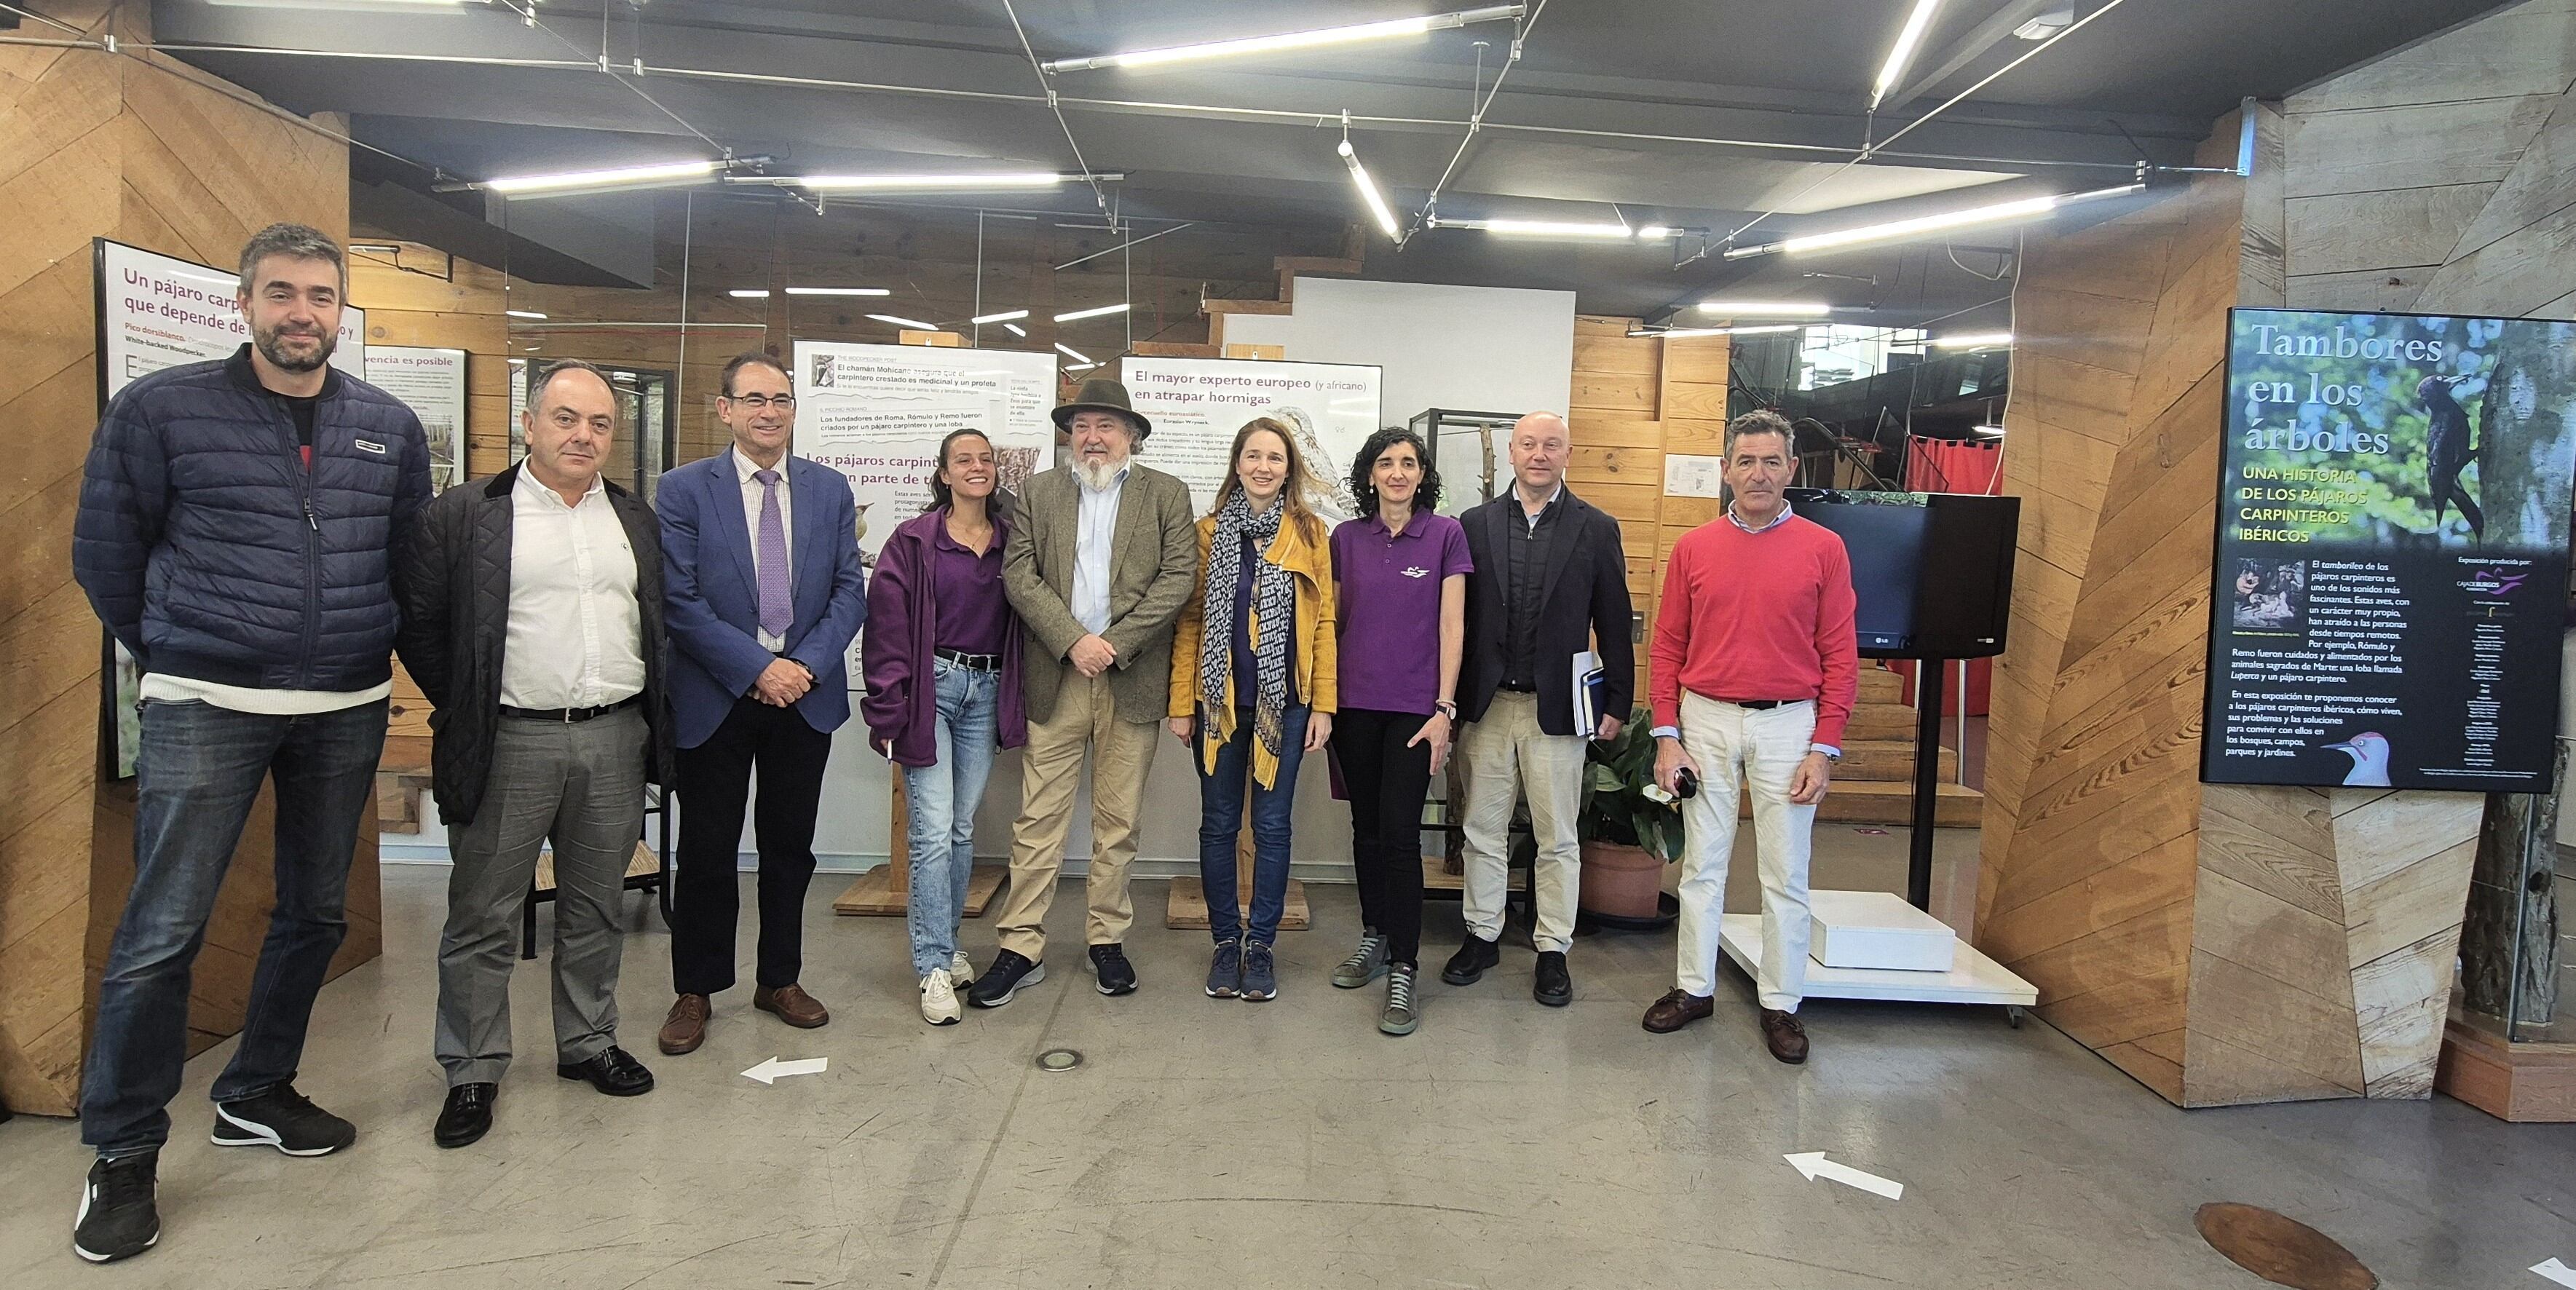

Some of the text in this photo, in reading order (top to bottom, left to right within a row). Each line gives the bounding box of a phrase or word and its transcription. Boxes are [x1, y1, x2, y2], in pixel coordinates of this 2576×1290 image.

[125, 267, 240, 313] Un pájaro carp
[125, 297, 245, 335] que depende de
[125, 322, 141, 332] Pico
[348, 328, 353, 340] y
[125, 335, 168, 349] White-backed
[2251, 324, 2443, 362] Tambores
[365, 355, 399, 364] vencia
[416, 358, 453, 366] posible
[1136, 371, 1367, 391] El mayor experto europeo (y africano)
[2249, 373, 2363, 406] en los
[1135, 391, 1271, 406] en atrapar hormigas
[2245, 418, 2388, 454] árboles
[835, 454, 885, 467] pájaros
[889, 456, 938, 470] carpint
[861, 474, 898, 486] parte
[903, 474, 919, 484] de
[2243, 467, 2356, 483] UNA HISTORIA
[2242, 487, 2368, 505] DE LOS PÁJAROS
[2240, 508, 2349, 523] CARPINTEROS
[2239, 526, 2310, 542] IBÉRICOS
[2322, 561, 2363, 569] tamborileo
[2377, 563, 2388, 571] los
[2312, 572, 2339, 581] pájaros
[2341, 574, 2385, 582] carpinteros
[2353, 585, 2382, 593] sonidos
[2385, 586, 2400, 594] más
[2310, 595, 2353, 604] fascinantes.
[2355, 596, 2374, 604] Estas
[2355, 609, 2371, 617] muy
[2324, 618, 2352, 626] atraído
[2334, 630, 2365, 639] tiempos
[2324, 641, 2356, 651] ejemplo,
[2358, 642, 2388, 650] Rómulo
[2232, 649, 2255, 657] Remo
[2258, 649, 2283, 657] fueron
[2285, 651, 2318, 659] cuidados
[2327, 652, 2372, 661] alimentados
[2374, 655, 2388, 663] por
[2390, 654, 2402, 662] los
[2232, 660, 2264, 668] animales
[2266, 662, 2299, 671] sagrados
[2374, 665, 2403, 673] llamada
[2231, 671, 2259, 681] Luperca
[2280, 673, 2304, 682] pájaro
[2305, 675, 2347, 684] carpintero.
[2232, 690, 2241, 698] En
[2261, 692, 2302, 701] exposición
[2249, 703, 2276, 712] pájaros
[2278, 704, 2321, 713] carpinteros
[2323, 705, 2355, 714] ibéricos,
[2357, 706, 2379, 714] cómo
[2381, 708, 2403, 716] viven,
[2243, 714, 2283, 723] problemas
[2291, 715, 2301, 723] las
[2303, 716, 2343, 724] soluciones
[2227, 735, 2305, 747] los bosques, campos,
[2226, 748, 2256, 757] parques
[2264, 748, 2296, 757] jardines.
